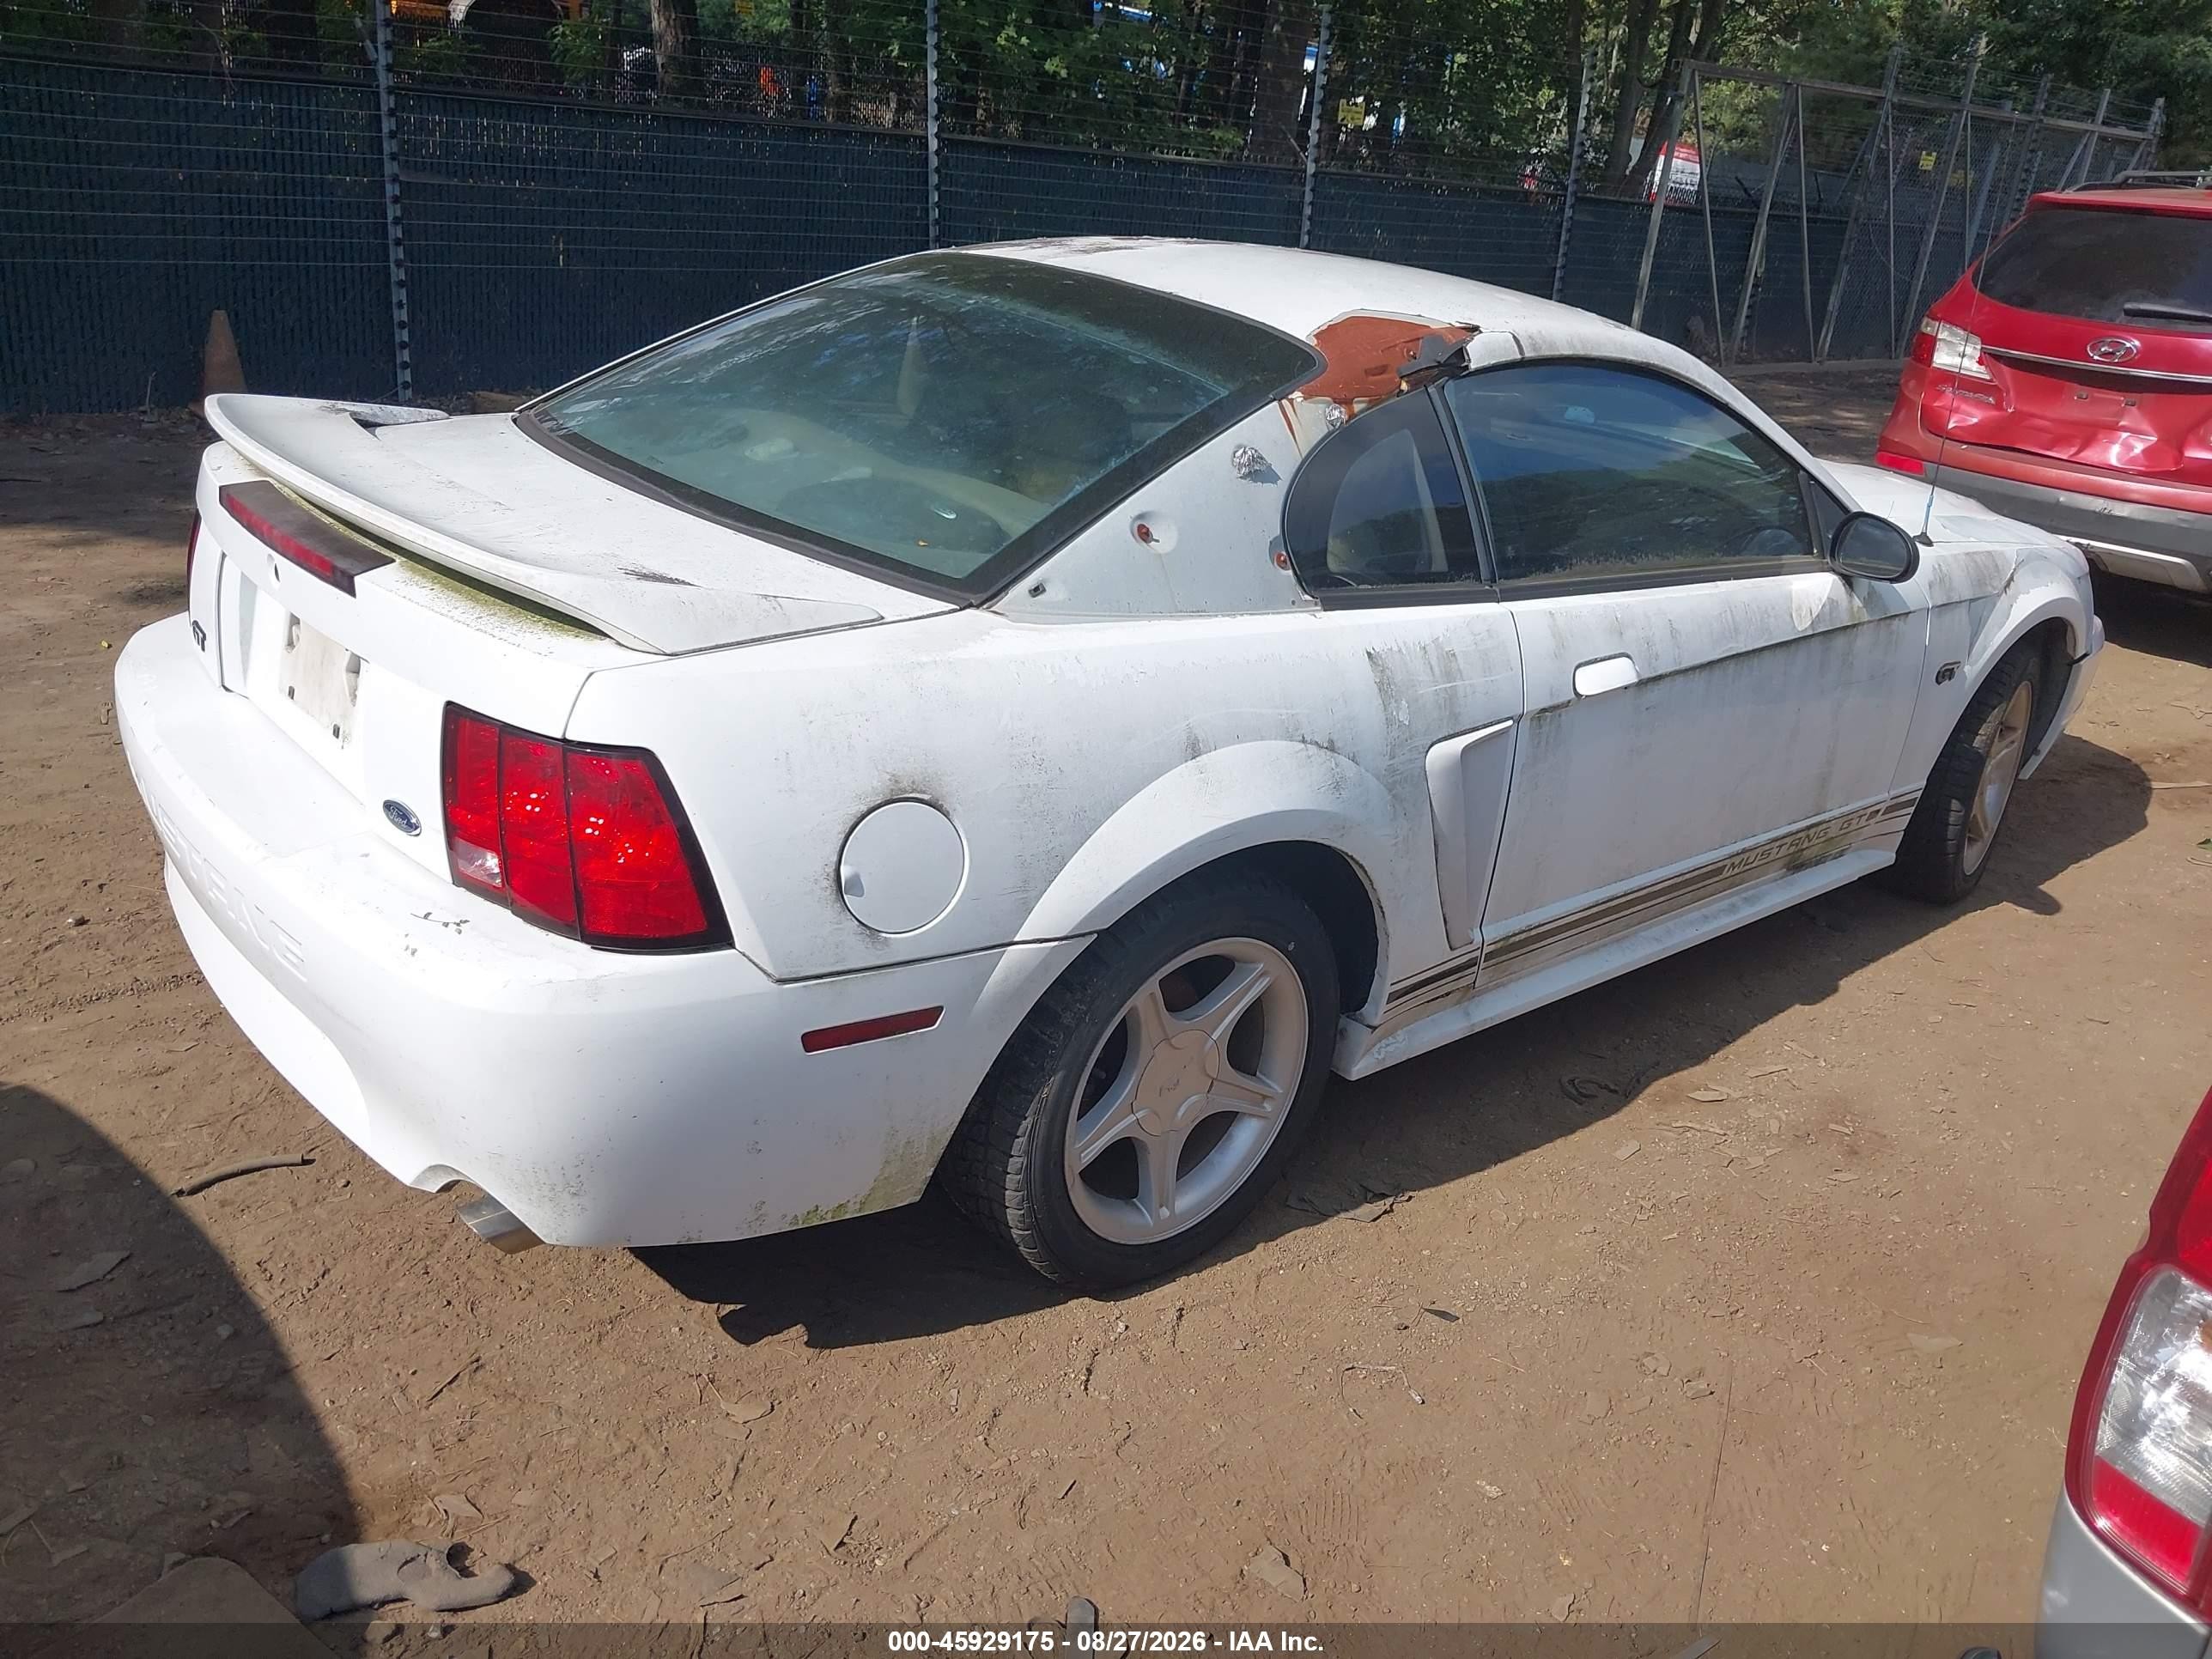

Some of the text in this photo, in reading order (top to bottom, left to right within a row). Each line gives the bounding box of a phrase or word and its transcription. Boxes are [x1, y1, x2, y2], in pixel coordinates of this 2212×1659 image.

[138, 777, 307, 982] USTANG
[1727, 813, 1868, 872] MUSTANG GT
